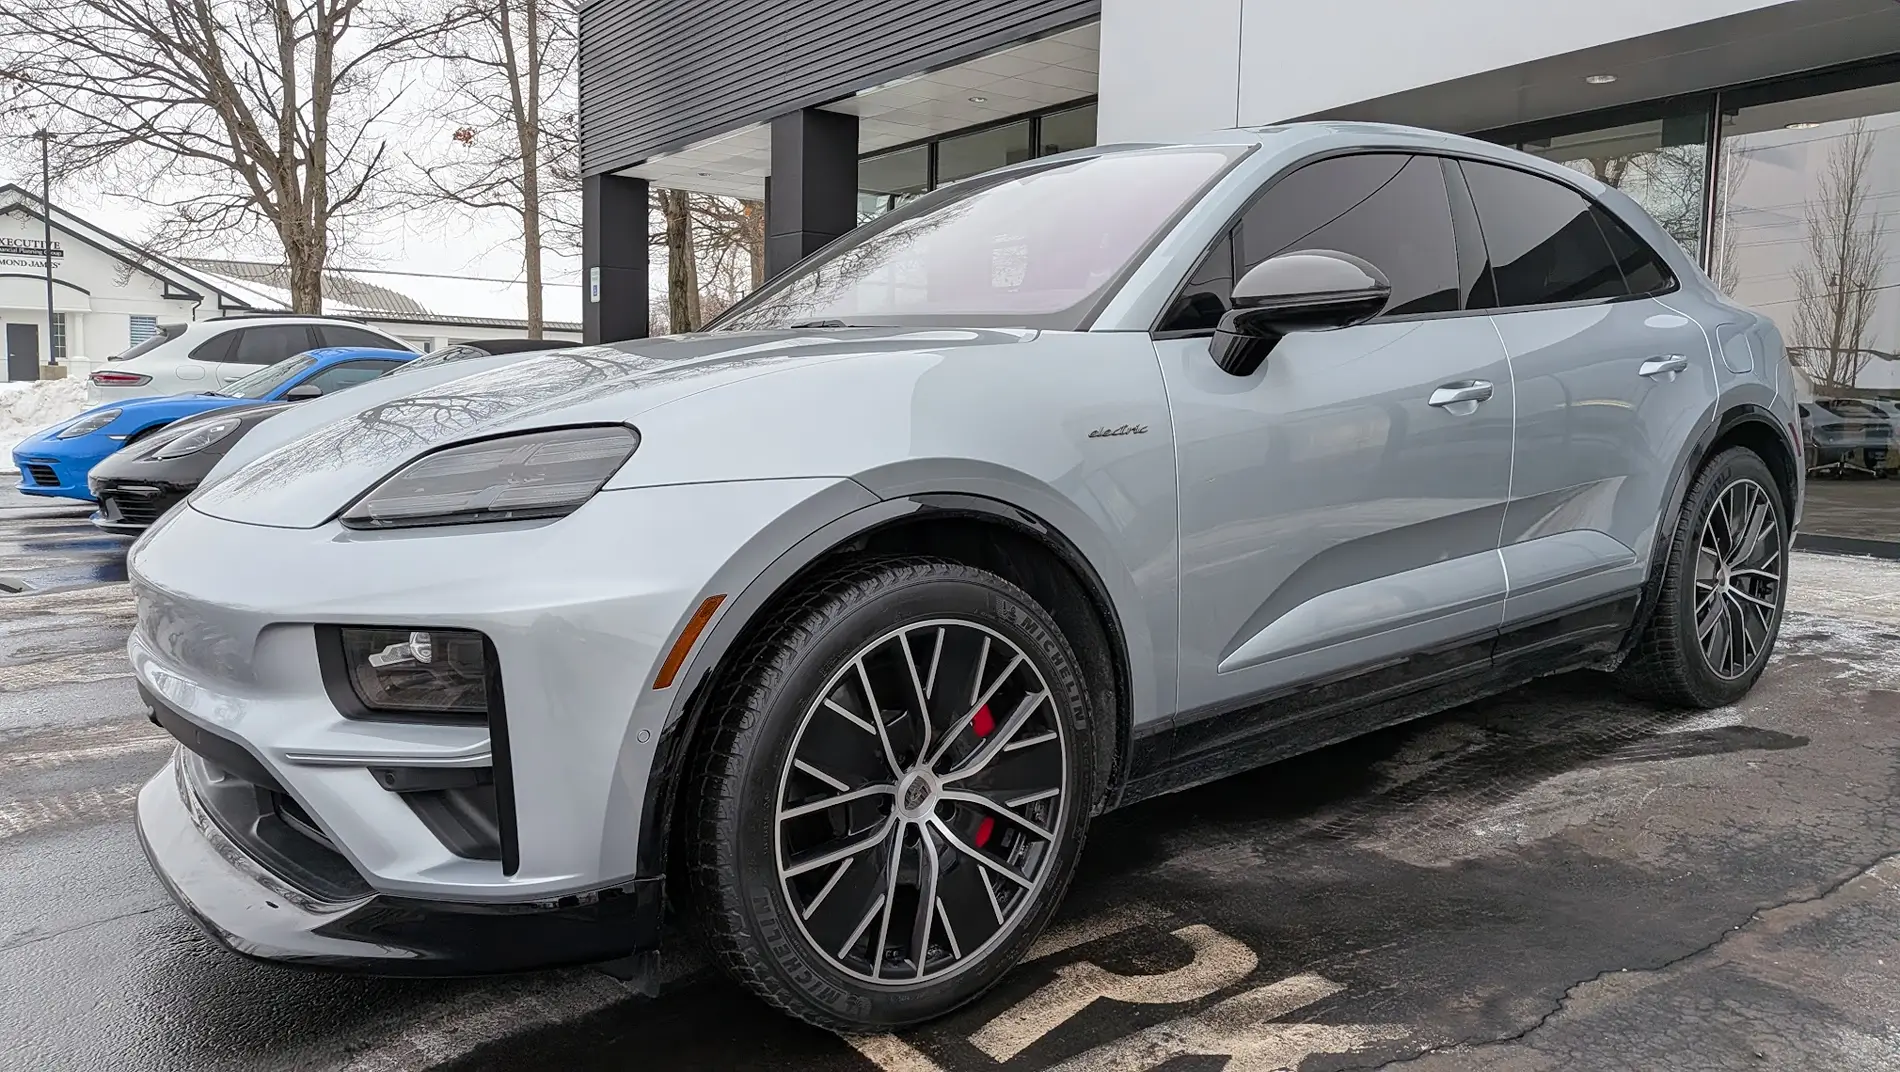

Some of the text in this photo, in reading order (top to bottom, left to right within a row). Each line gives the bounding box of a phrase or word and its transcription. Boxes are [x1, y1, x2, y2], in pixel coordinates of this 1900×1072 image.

[1088, 424, 1148, 438] electric
[1021, 616, 1085, 722] MICHELIN
[752, 896, 842, 1005] MICHELIN
